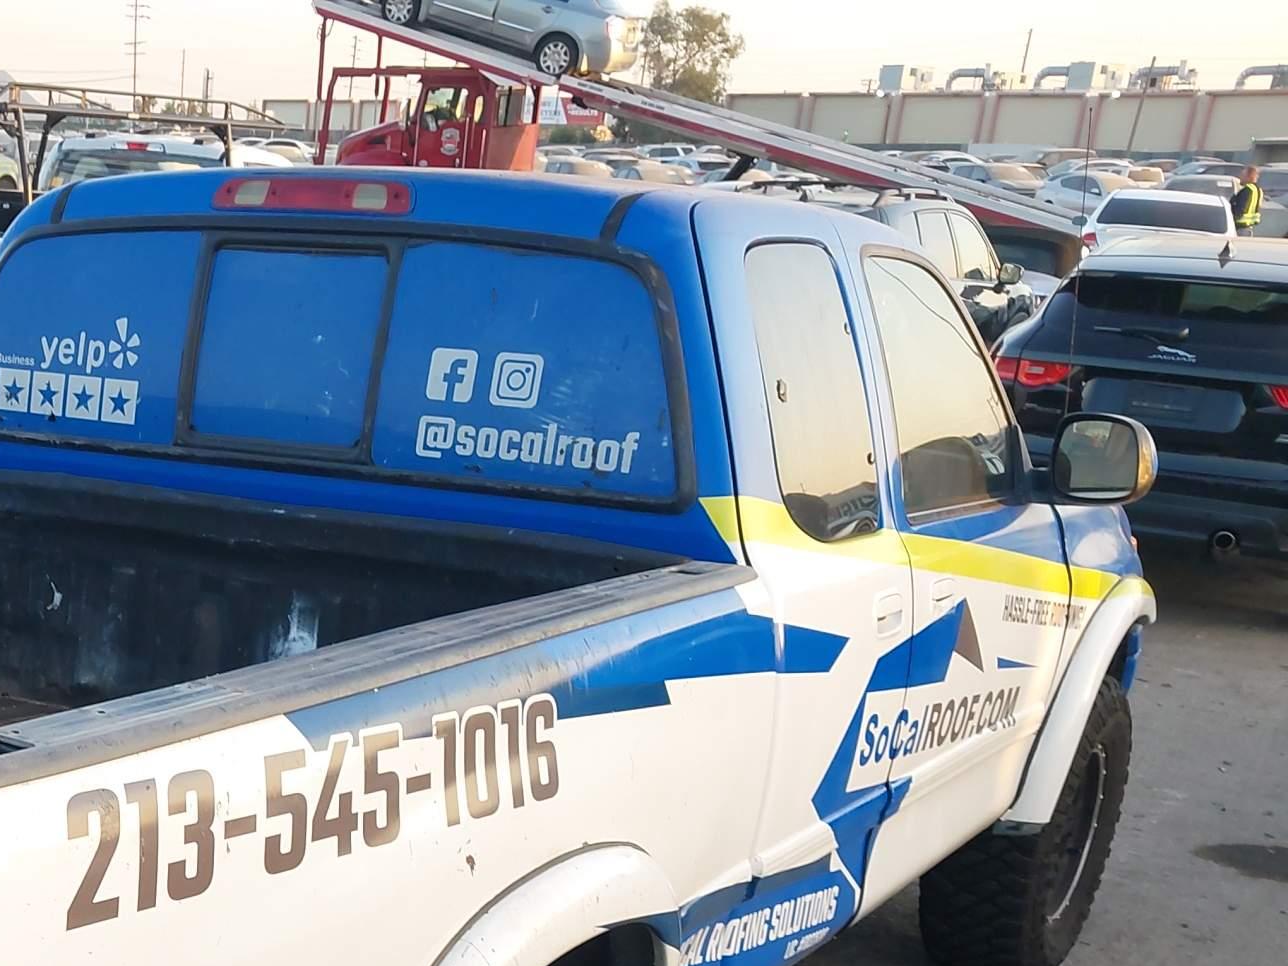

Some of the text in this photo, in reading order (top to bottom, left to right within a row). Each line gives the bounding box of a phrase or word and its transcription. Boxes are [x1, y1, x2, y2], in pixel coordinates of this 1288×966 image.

[41, 331, 105, 374] yelp
[415, 415, 640, 474] @socalroof
[859, 685, 1021, 767] SoCalROOF.COM
[66, 699, 559, 931] 213-545-1016
[769, 885, 840, 941] SOLUTIONS
